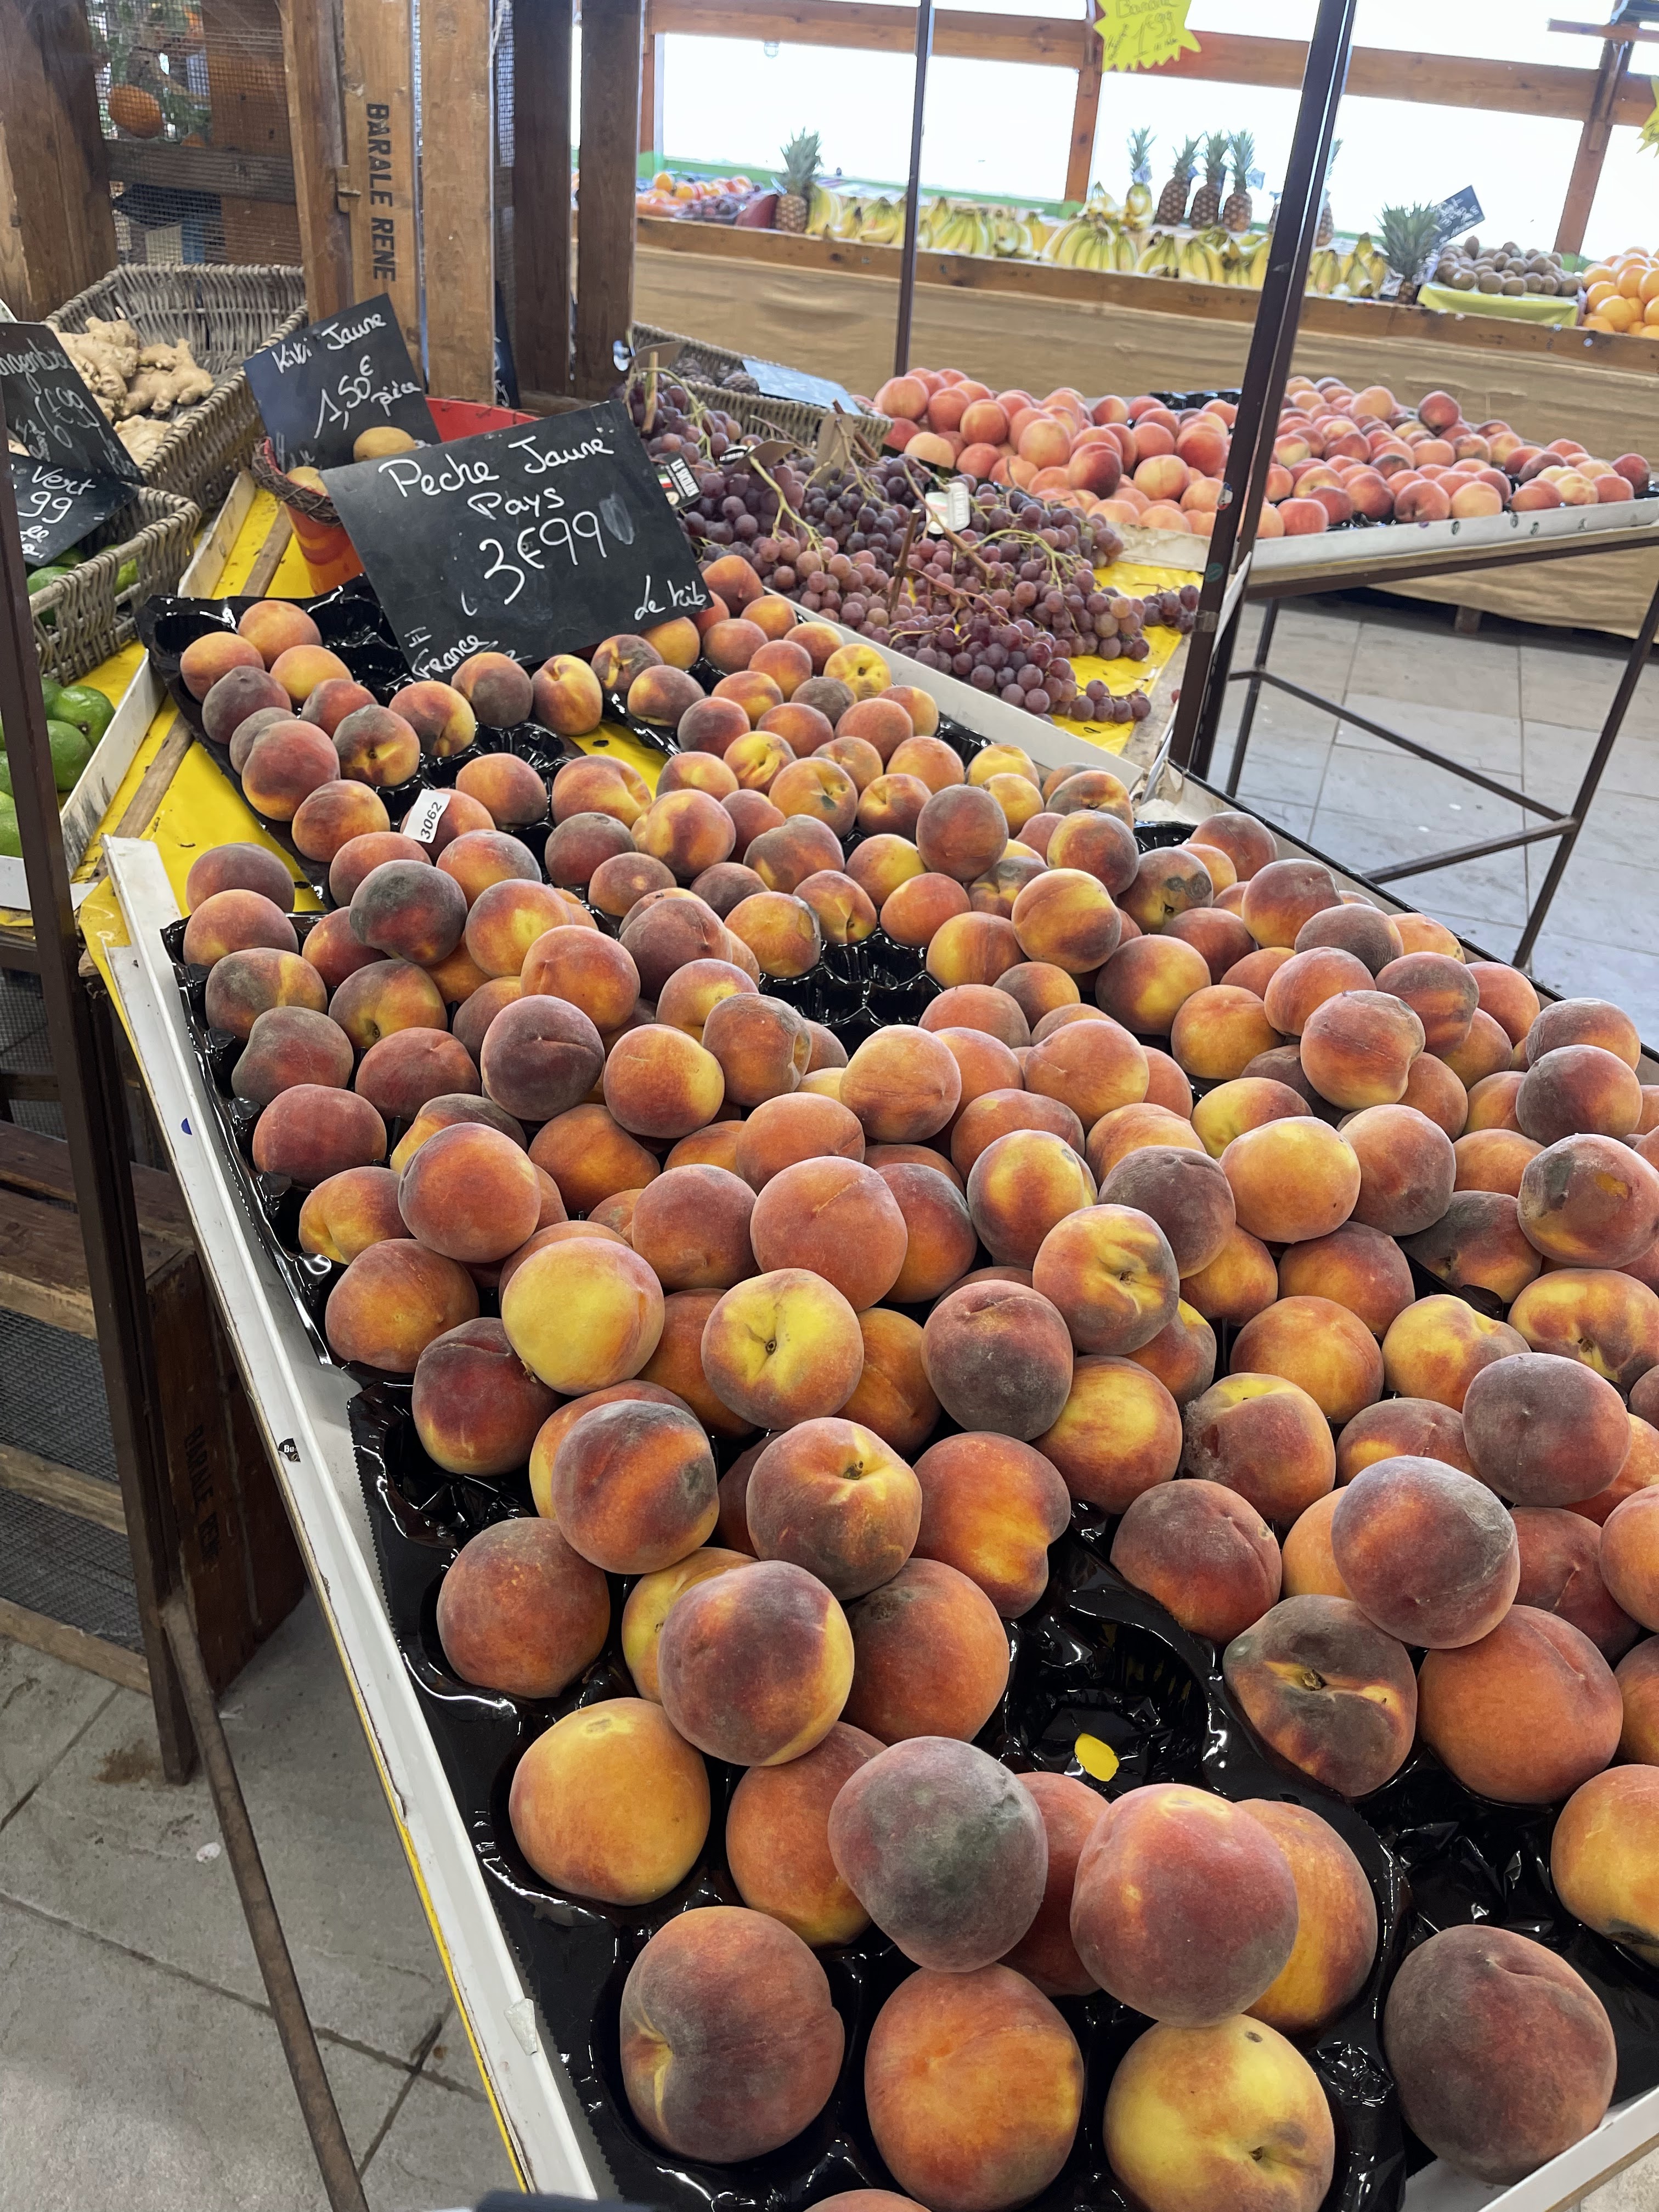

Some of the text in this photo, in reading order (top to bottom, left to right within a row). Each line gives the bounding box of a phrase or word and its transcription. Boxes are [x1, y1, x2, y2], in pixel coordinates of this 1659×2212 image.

[366, 104, 396, 281] BARALE RENE
[321, 313, 387, 350] Jaune
[31, 466, 97, 495] Vert
[378, 436, 615, 497] Peche Jaune
[467, 487, 565, 520] Pays
[634, 574, 667, 620] le
[421, 802, 442, 840] 3062
[284, 1444, 297, 1453] Bu
